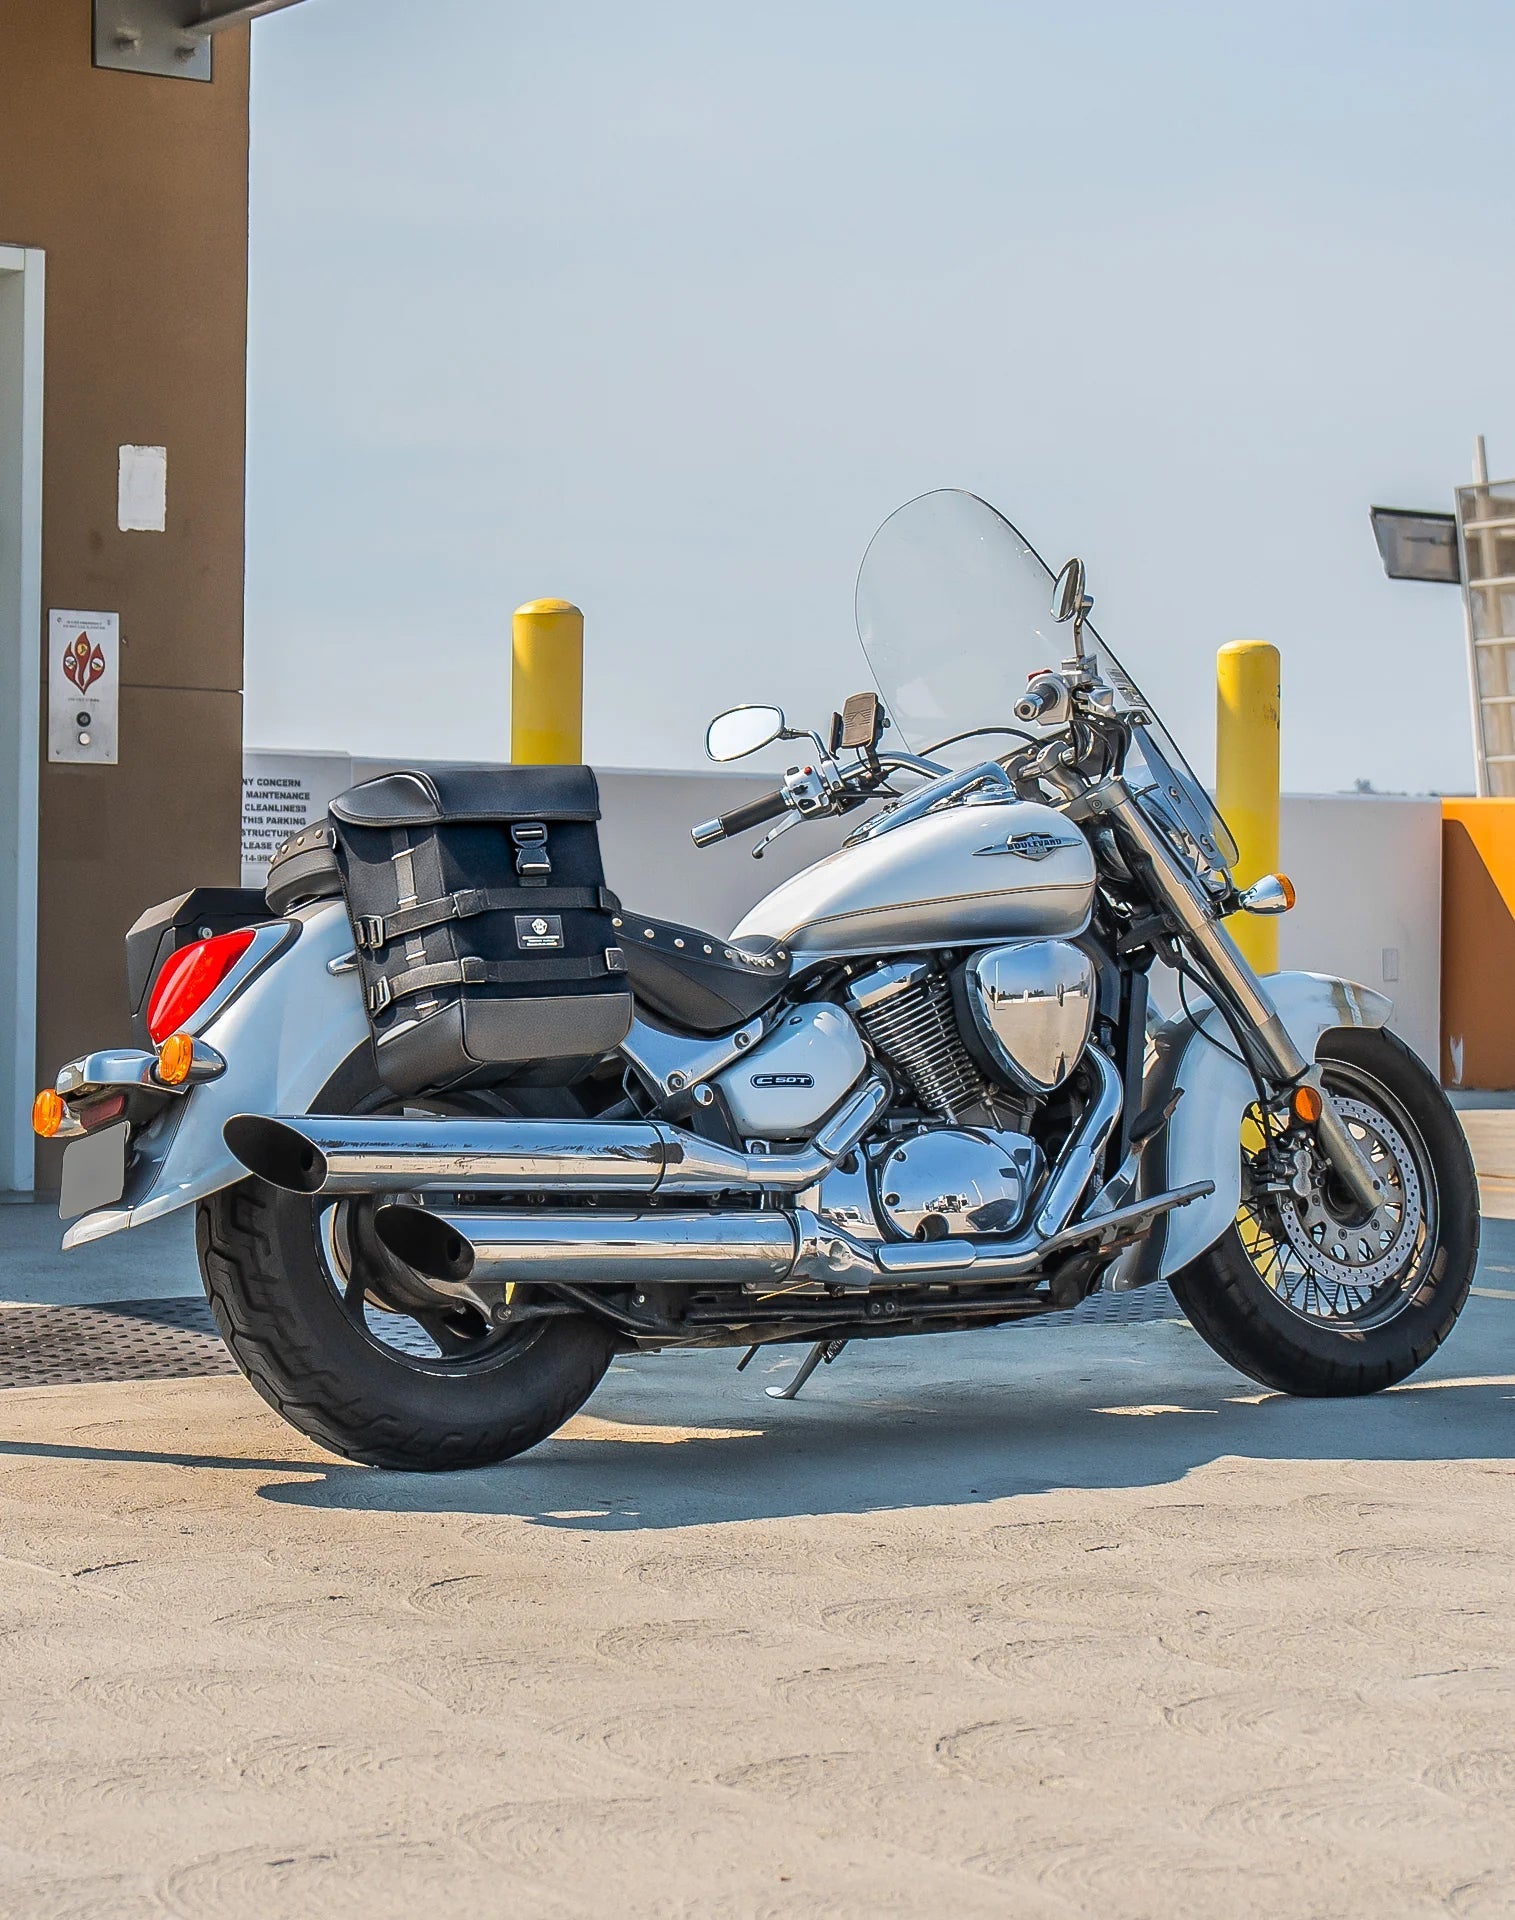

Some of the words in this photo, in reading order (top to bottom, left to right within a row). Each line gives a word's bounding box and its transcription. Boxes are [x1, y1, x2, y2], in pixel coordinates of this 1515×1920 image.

[257, 779, 301, 787] CONCERN
[246, 791, 310, 800] MAINTENANCE
[244, 804, 306, 813] CLEANLINESS
[242, 816, 263, 824] THIS
[266, 817, 306, 826] PARKING
[241, 842, 272, 850] LEASE
[1007, 838, 1062, 850] BOULEVARD
